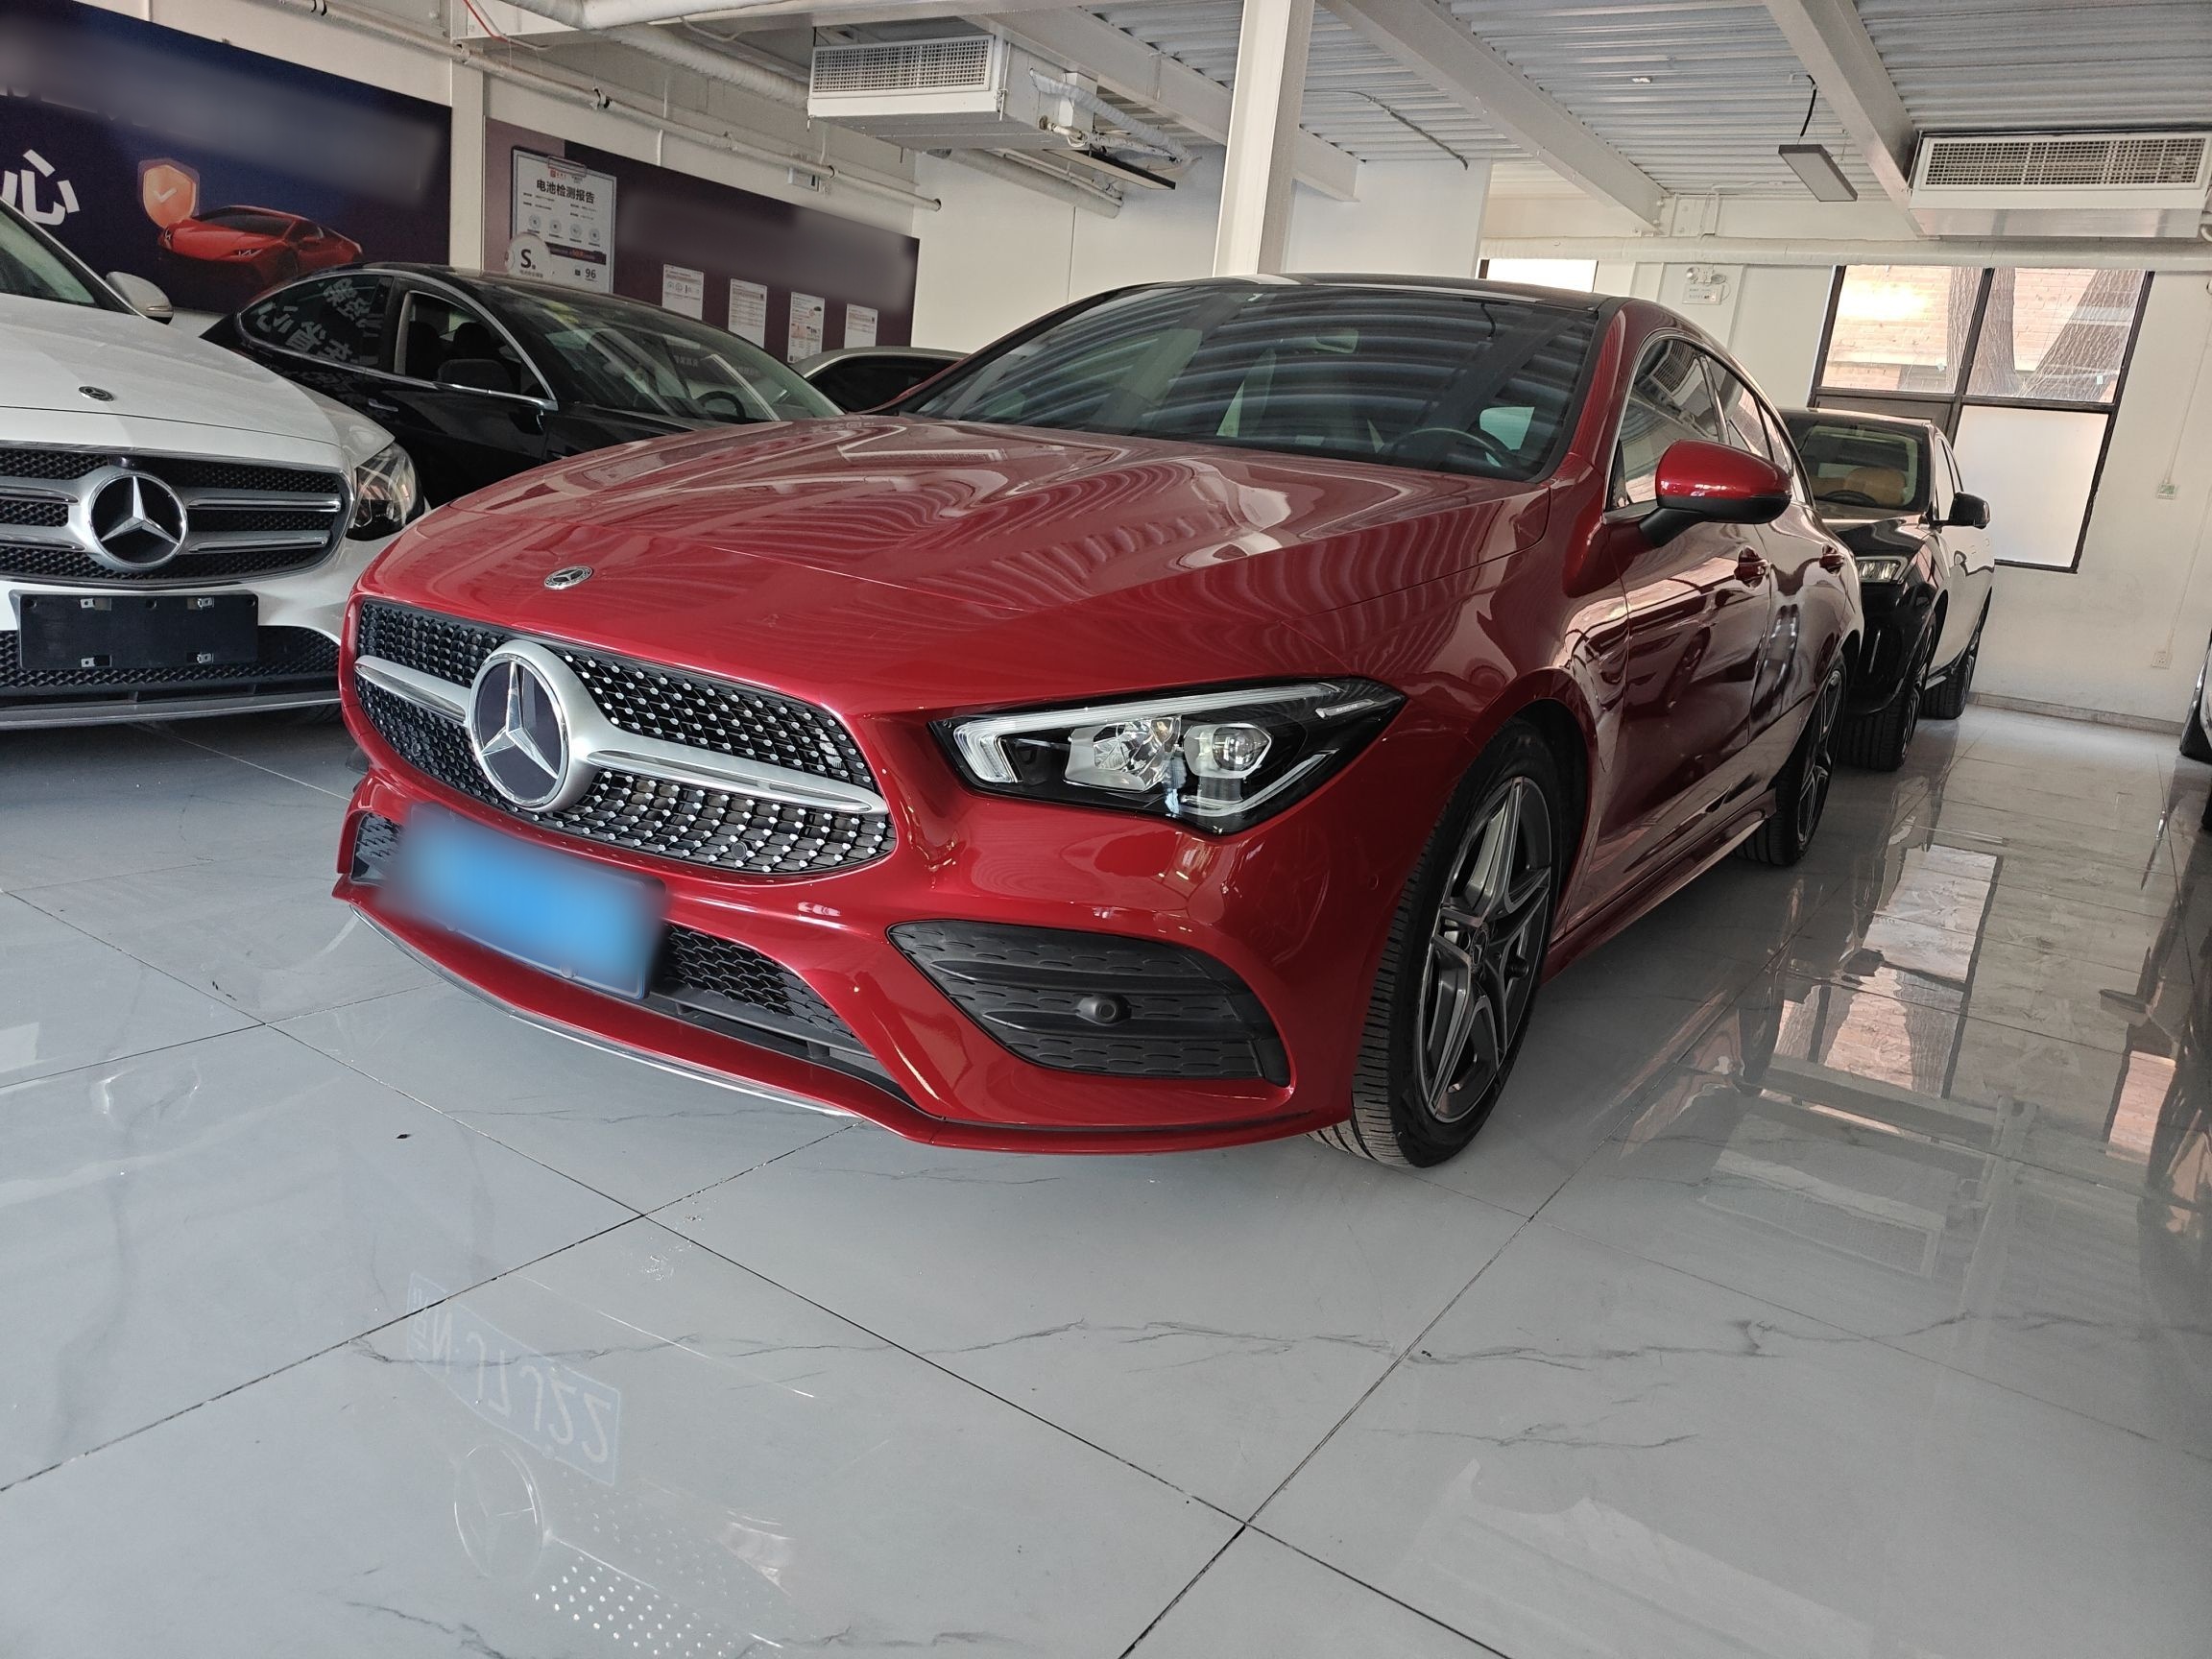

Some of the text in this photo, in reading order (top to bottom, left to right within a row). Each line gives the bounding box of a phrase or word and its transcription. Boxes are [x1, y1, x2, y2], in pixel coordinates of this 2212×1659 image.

[1, 149, 80, 225] 心
[537, 179, 595, 204] 电池检测报告
[585, 268, 596, 278] 96
